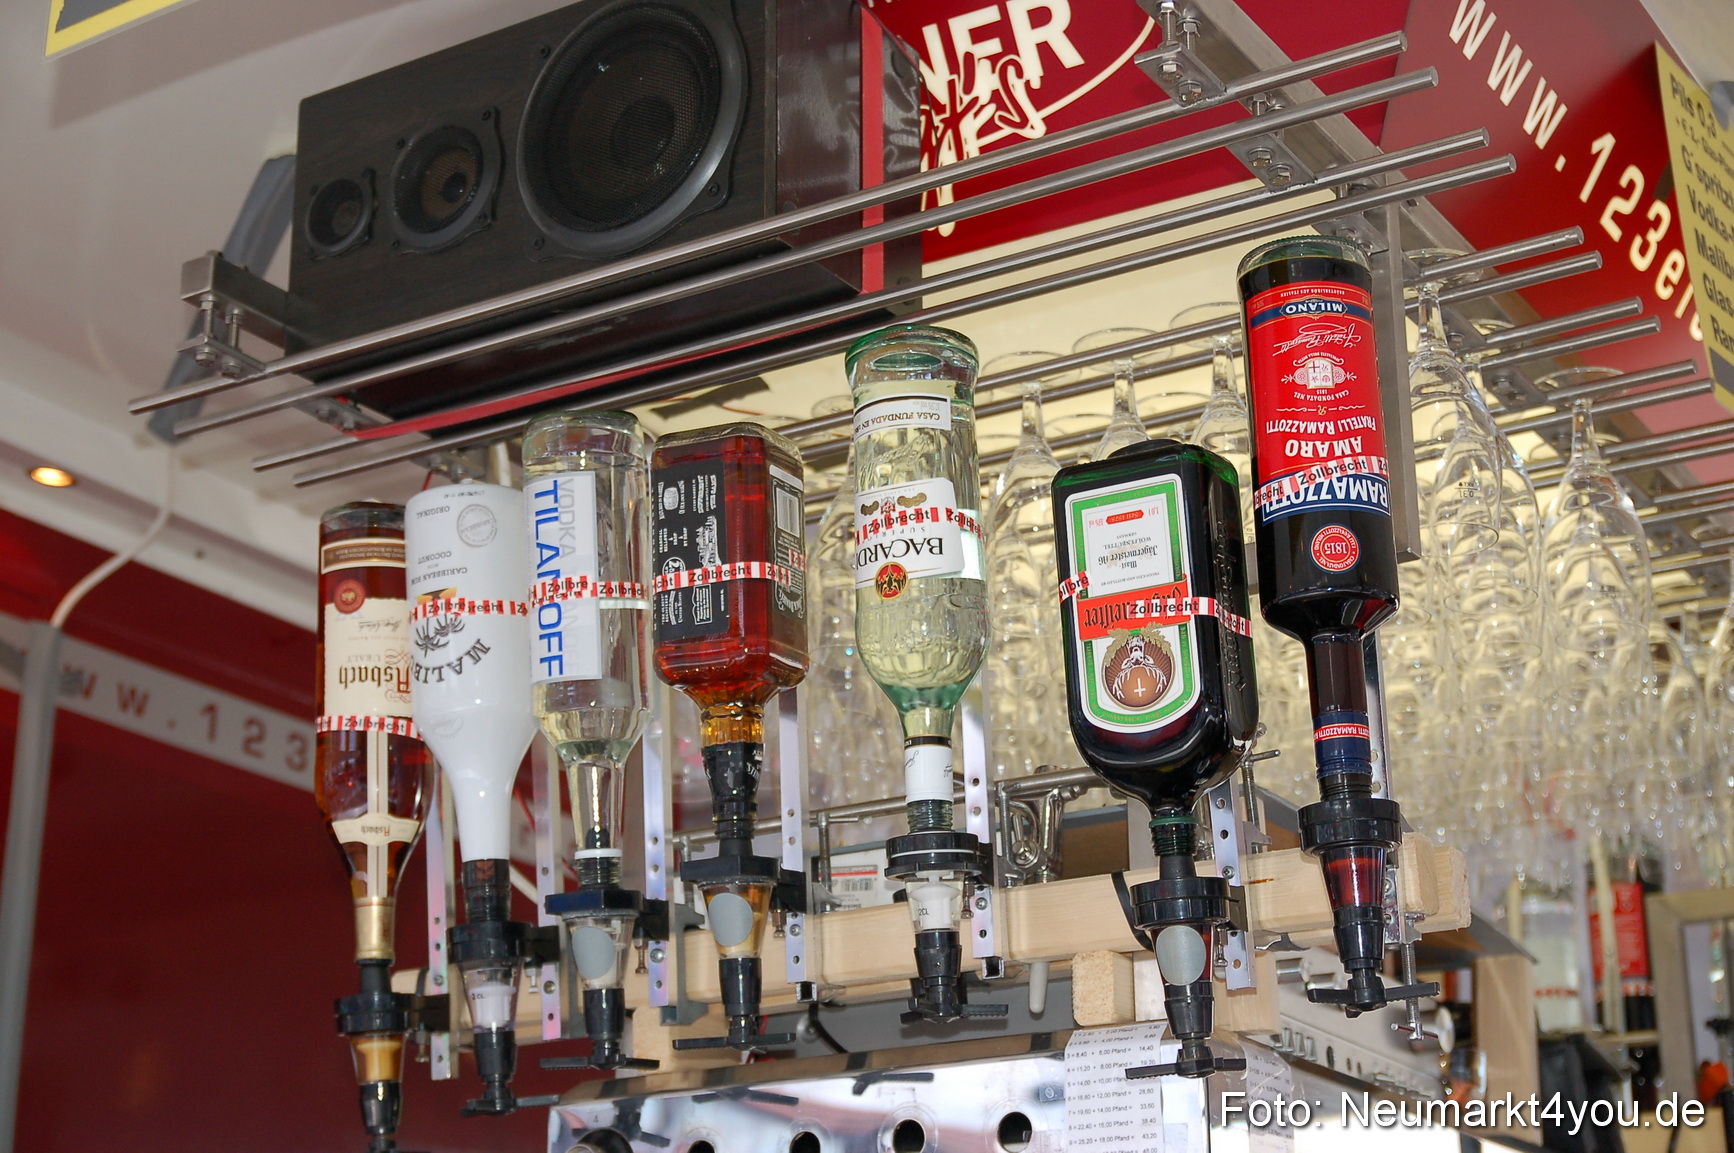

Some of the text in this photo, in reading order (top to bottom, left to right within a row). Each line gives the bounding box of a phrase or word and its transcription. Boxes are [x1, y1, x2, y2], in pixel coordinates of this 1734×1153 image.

[1285, 302, 1343, 314] MILANO
[1307, 394, 1335, 402] FONDATA
[871, 412, 915, 423] FUNDADA
[916, 412, 940, 421] CASA
[1266, 415, 1377, 435] FRATELLI RAMAZZOTTI
[1285, 436, 1363, 458] AMARO
[1298, 460, 1366, 486] Zollbrecht
[416, 505, 450, 519] ORIGINAL
[558, 478, 577, 559] VODKA
[868, 510, 930, 533] Zollbrecht
[1324, 542, 1347, 555] 1815
[418, 551, 452, 565] COCONUT
[423, 567, 468, 581] CARIBBEAN
[689, 565, 751, 582] Zollbrecht
[1130, 600, 1199, 615] Zollbrecht
[339, 666, 411, 694] Asbach
[345, 717, 405, 733] Zollbrecht
[1318, 726, 1357, 739] RAMAZZOTTI
